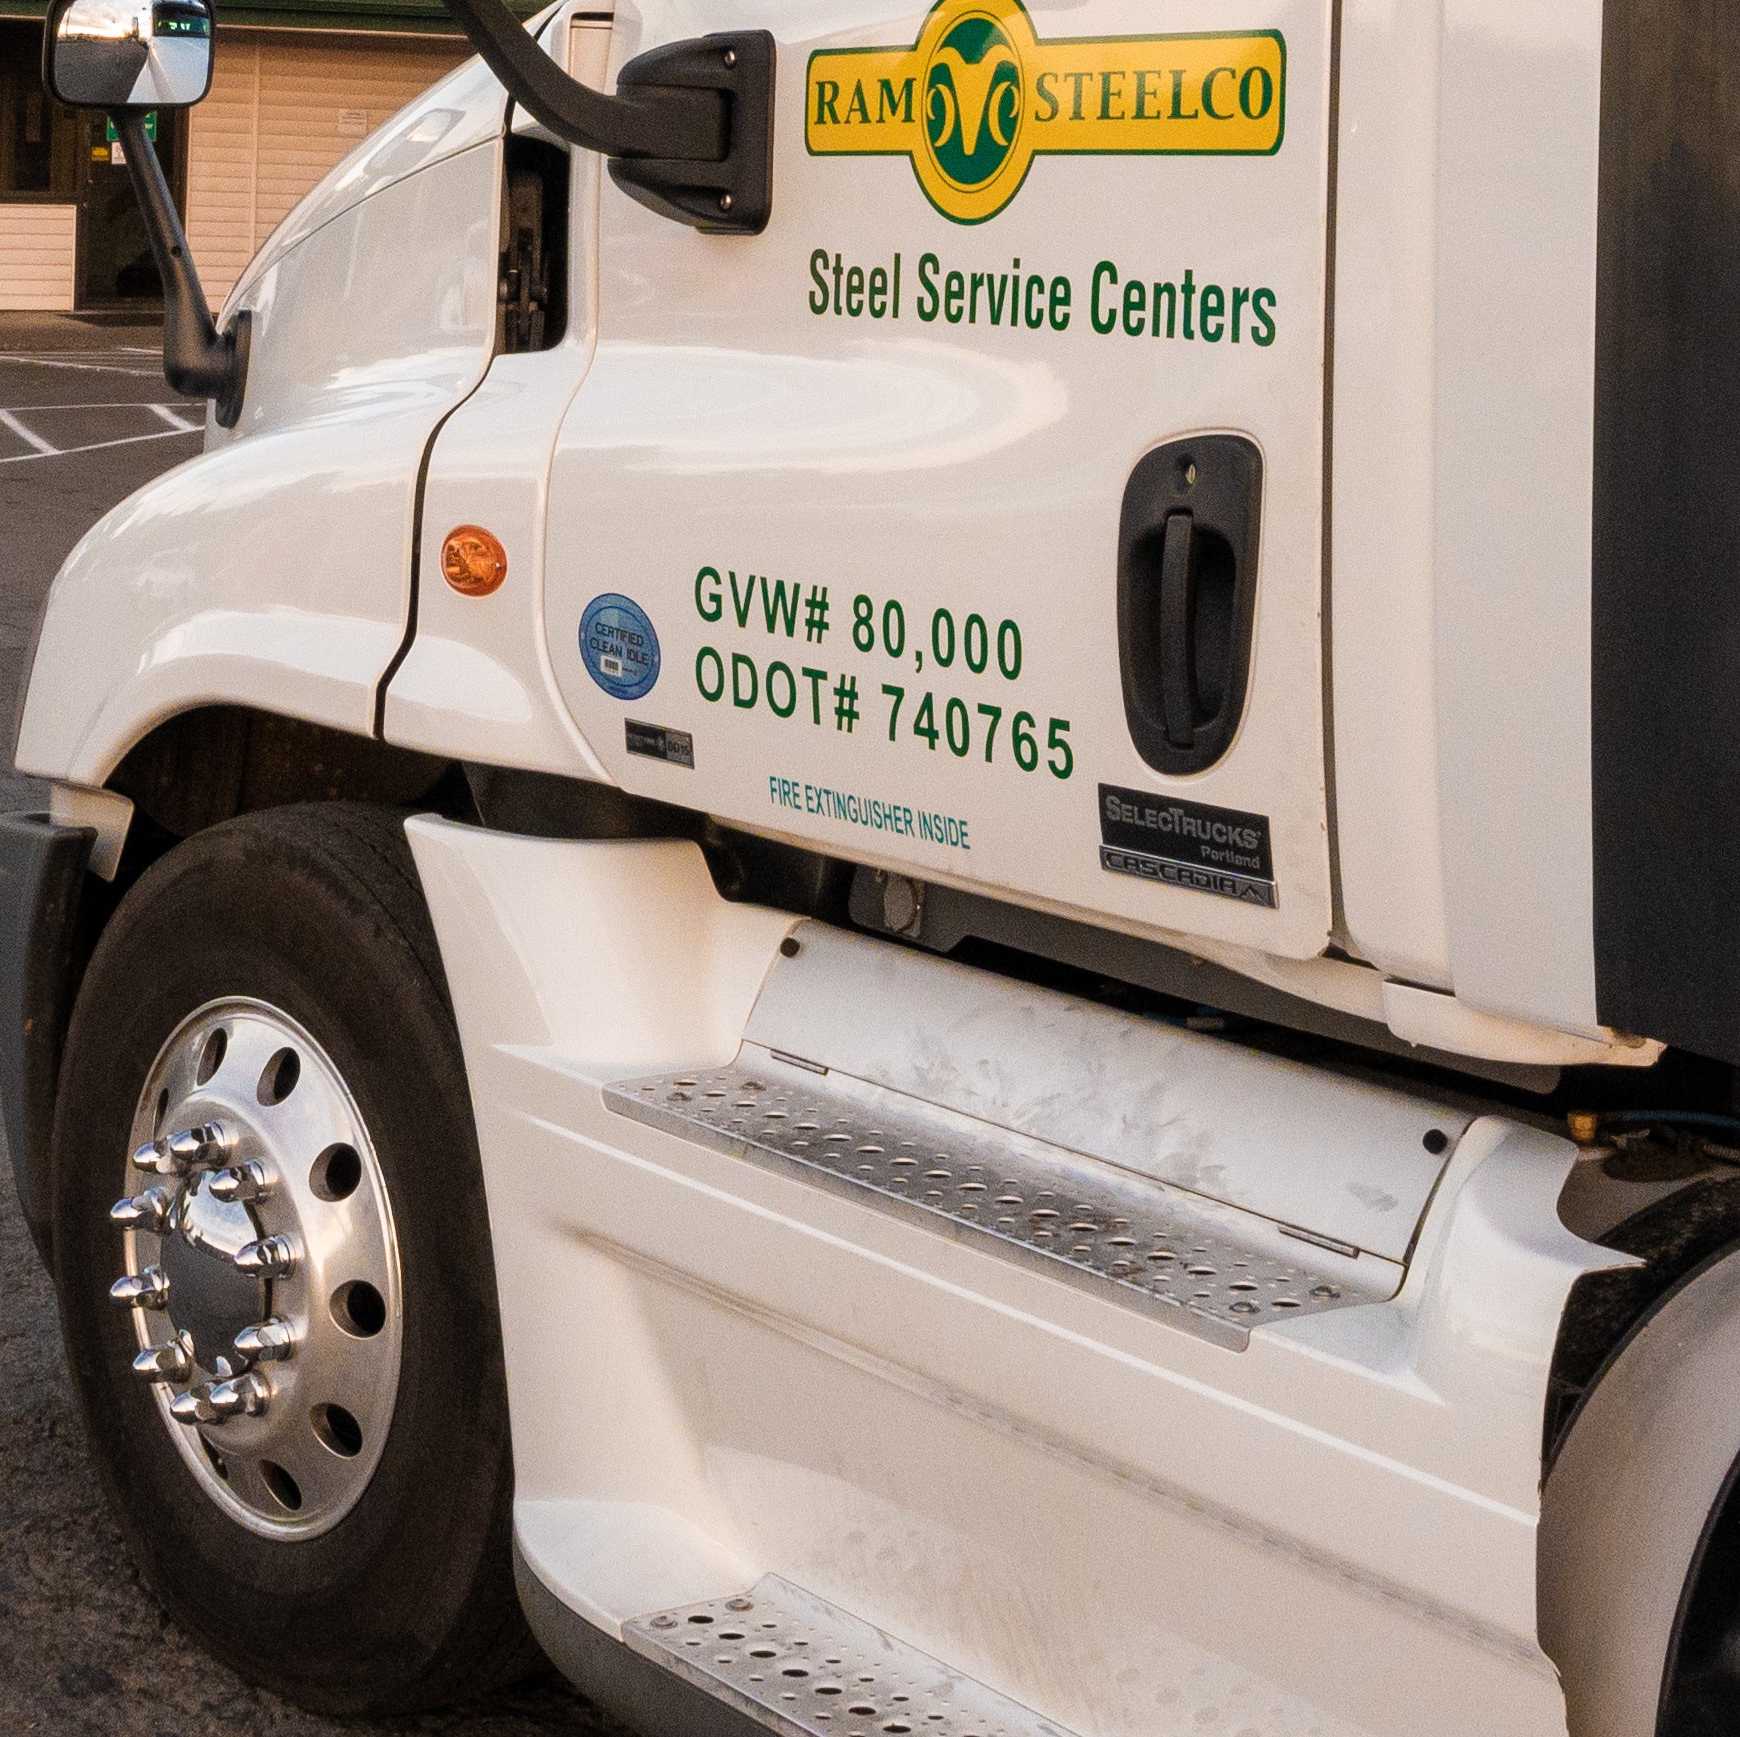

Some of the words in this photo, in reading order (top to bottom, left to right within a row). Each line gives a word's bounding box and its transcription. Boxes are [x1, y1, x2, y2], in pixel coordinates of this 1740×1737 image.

[814, 77, 917, 125] RAM
[1034, 65, 1273, 123] STEELCO
[808, 248, 901, 319] Steel
[916, 252, 1072, 332] Service
[1090, 260, 1277, 347] Centers
[589, 637, 623, 659] CLEAN
[626, 648, 649, 666] IDLE
[595, 622, 645, 648] CERTIFIED
[694, 566, 830, 644] GVW#
[852, 594, 1023, 681] 80,000
[695, 645, 860, 733] ODOT#
[881, 683, 1075, 781] 740765
[769, 775, 802, 810] FIRE
[804, 784, 916, 837] EXTINGUISHER
[918, 810, 971, 850] INSIDE
[1200, 845, 1261, 870] Portland
